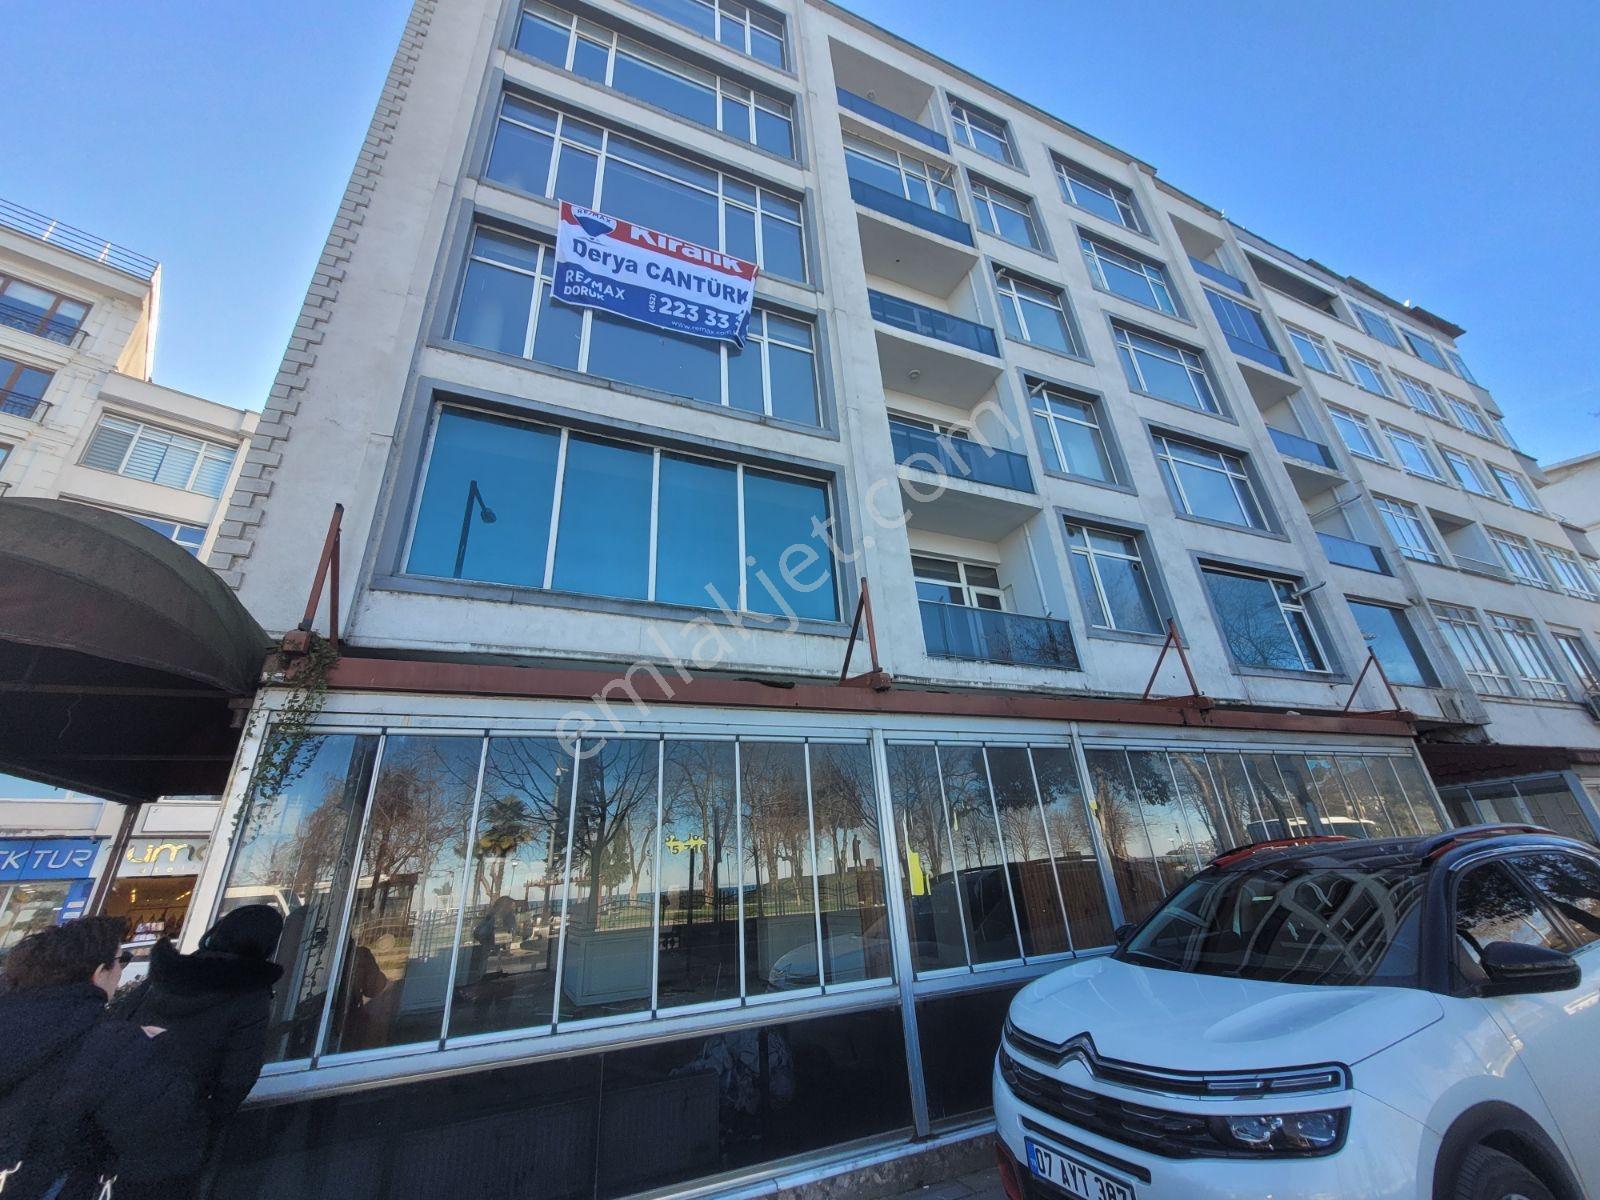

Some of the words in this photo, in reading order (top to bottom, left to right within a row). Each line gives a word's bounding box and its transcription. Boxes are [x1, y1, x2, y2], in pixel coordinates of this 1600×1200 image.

[565, 269, 625, 300] RE/MAX
[572, 238, 638, 274] Derya
[645, 261, 749, 305] CANTÜRK
[563, 284, 605, 301] DORUK
[659, 297, 699, 322] 223
[704, 308, 730, 329] 33
[1034, 1147, 1053, 1178] 07
[1060, 1159, 1090, 1197] AYT
